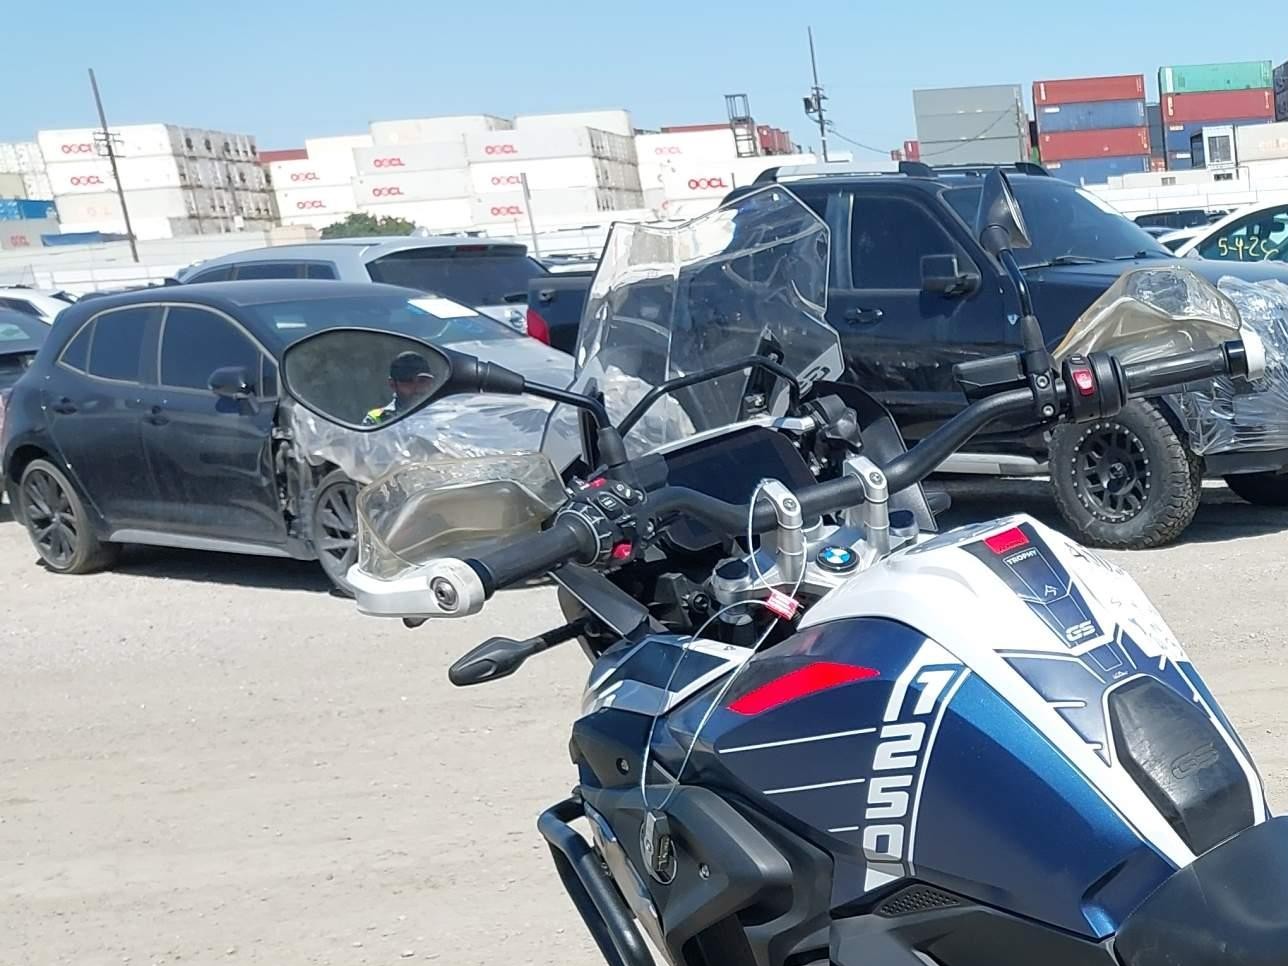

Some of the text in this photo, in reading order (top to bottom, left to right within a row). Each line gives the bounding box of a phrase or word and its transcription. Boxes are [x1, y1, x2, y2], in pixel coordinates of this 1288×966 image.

[484, 144, 518, 155] OOCL
[373, 158, 405, 168] OOCL
[70, 175, 104, 186] OOCL
[290, 172, 320, 182] OOCL
[491, 175, 523, 186] OOCL
[688, 178, 728, 190] OOCL
[372, 186, 404, 197] OOCL
[296, 200, 327, 210] OOCL
[490, 206, 524, 216] OOCL
[1006, 549, 1038, 566] TROPHY
[1065, 620, 1096, 642] GS
[863, 667, 952, 862] 1250
